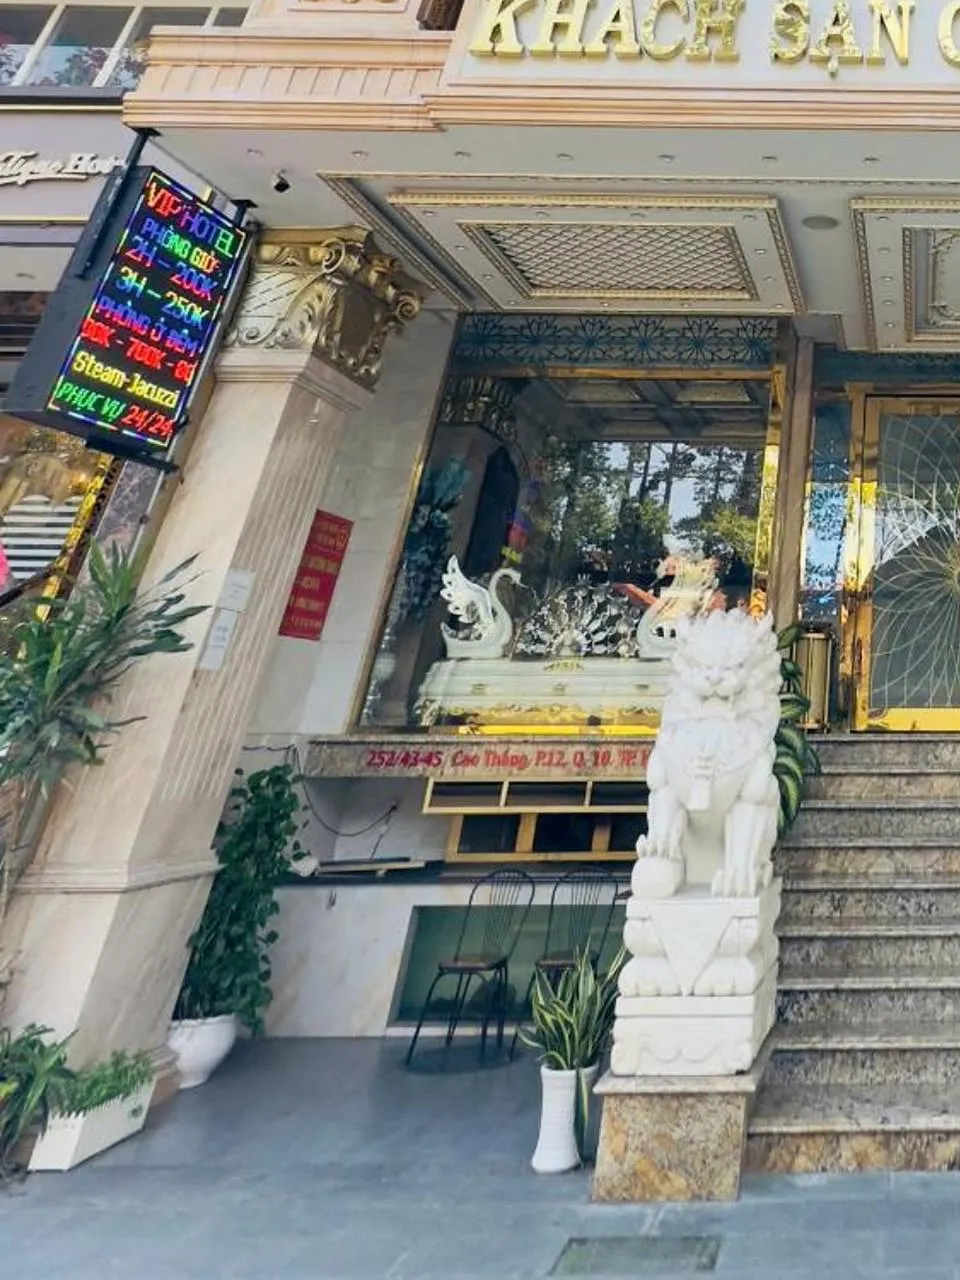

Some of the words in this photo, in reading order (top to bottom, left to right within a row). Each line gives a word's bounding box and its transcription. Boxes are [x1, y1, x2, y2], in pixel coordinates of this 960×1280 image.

[147, 182, 183, 218] VIP
[179, 207, 235, 259] HOTEL
[115, 265, 148, 298] 3H
[160, 291, 210, 330] 250K
[125, 234, 158, 268] 2H
[170, 262, 219, 301] 200K
[120, 404, 174, 437] 24/24
